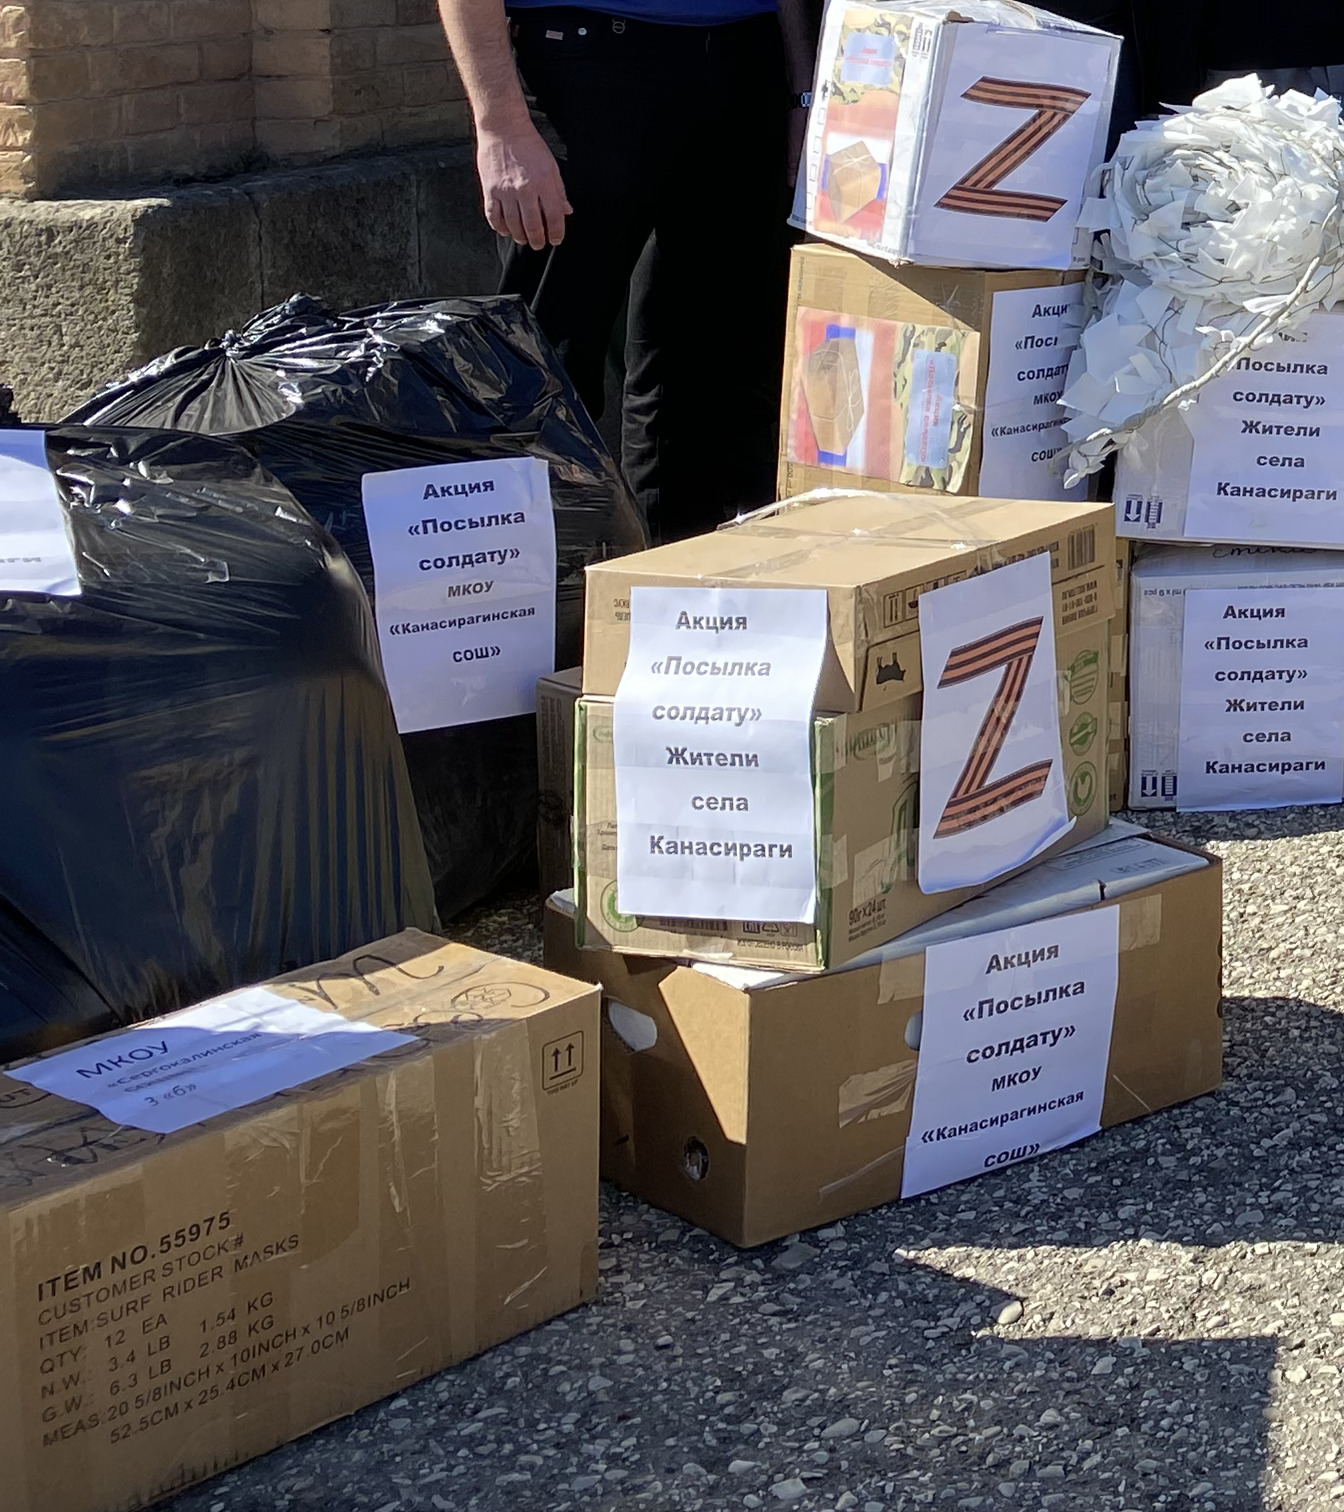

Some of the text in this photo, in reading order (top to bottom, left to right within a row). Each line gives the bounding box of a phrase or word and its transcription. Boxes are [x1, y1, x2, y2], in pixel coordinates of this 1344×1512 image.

[1032, 304, 1070, 318] Акци
[1015, 335, 1058, 350] «Пос
[1017, 363, 1068, 381] солдат
[1236, 357, 1329, 375] Посылка
[1232, 390, 1326, 409] солдату»
[1241, 420, 1320, 437] Жители
[1256, 455, 1305, 468] села
[422, 480, 495, 500] Акция
[1216, 482, 1338, 502] Канасираги
[408, 511, 526, 537] «Посылка
[419, 548, 520, 571] солдату»
[447, 580, 494, 598] МКОУ
[389, 606, 536, 636] «Канасирагинская
[675, 611, 748, 634] Акция
[1223, 605, 1286, 620] Акция
[1204, 637, 1308, 651] «Посылка
[650, 655, 772, 677] «Посылка
[1214, 668, 1308, 683] солдату»
[651, 705, 763, 727] солдату»
[1225, 699, 1305, 713] Жители
[1243, 730, 1292, 743] села
[665, 746, 760, 768] Жители
[1205, 760, 1326, 776] Канасираги
[691, 795, 749, 812] села
[649, 835, 793, 861] Канасираги
[986, 944, 1059, 974] Акция
[963, 980, 1085, 1022] «Посылка
[966, 1025, 1076, 1064] солдату»
[76, 1040, 169, 1079] МКОУ
[991, 1066, 1042, 1092] МКОУ
[921, 1091, 1084, 1143] «Канасирагинская
[163, 1266, 223, 1302] RIDER
[234, 1234, 299, 1273] MASKS
[38, 1261, 102, 1301] ITEM
[38, 1269, 156, 1326] CUSTOMER
[105, 1329, 126, 1349] 12
[142, 1313, 168, 1335] EA
[108, 1350, 136, 1372] 3.4
[147, 1335, 170, 1357] LB
[200, 1308, 236, 1332] 1.54
[247, 1292, 273, 1314] KG
[231, 1327, 297, 1368] 10INCH
[317, 1311, 335, 1330] 10
[109, 1373, 138, 1396] 6.3
[149, 1359, 172, 1380] LB
[200, 1331, 238, 1358] 2.88
[248, 1315, 274, 1337] KG
[110, 1402, 179, 1444] 52.5CM
[199, 1364, 266, 1405] 25.4CM
[284, 1327, 349, 1368] 27.0CM
